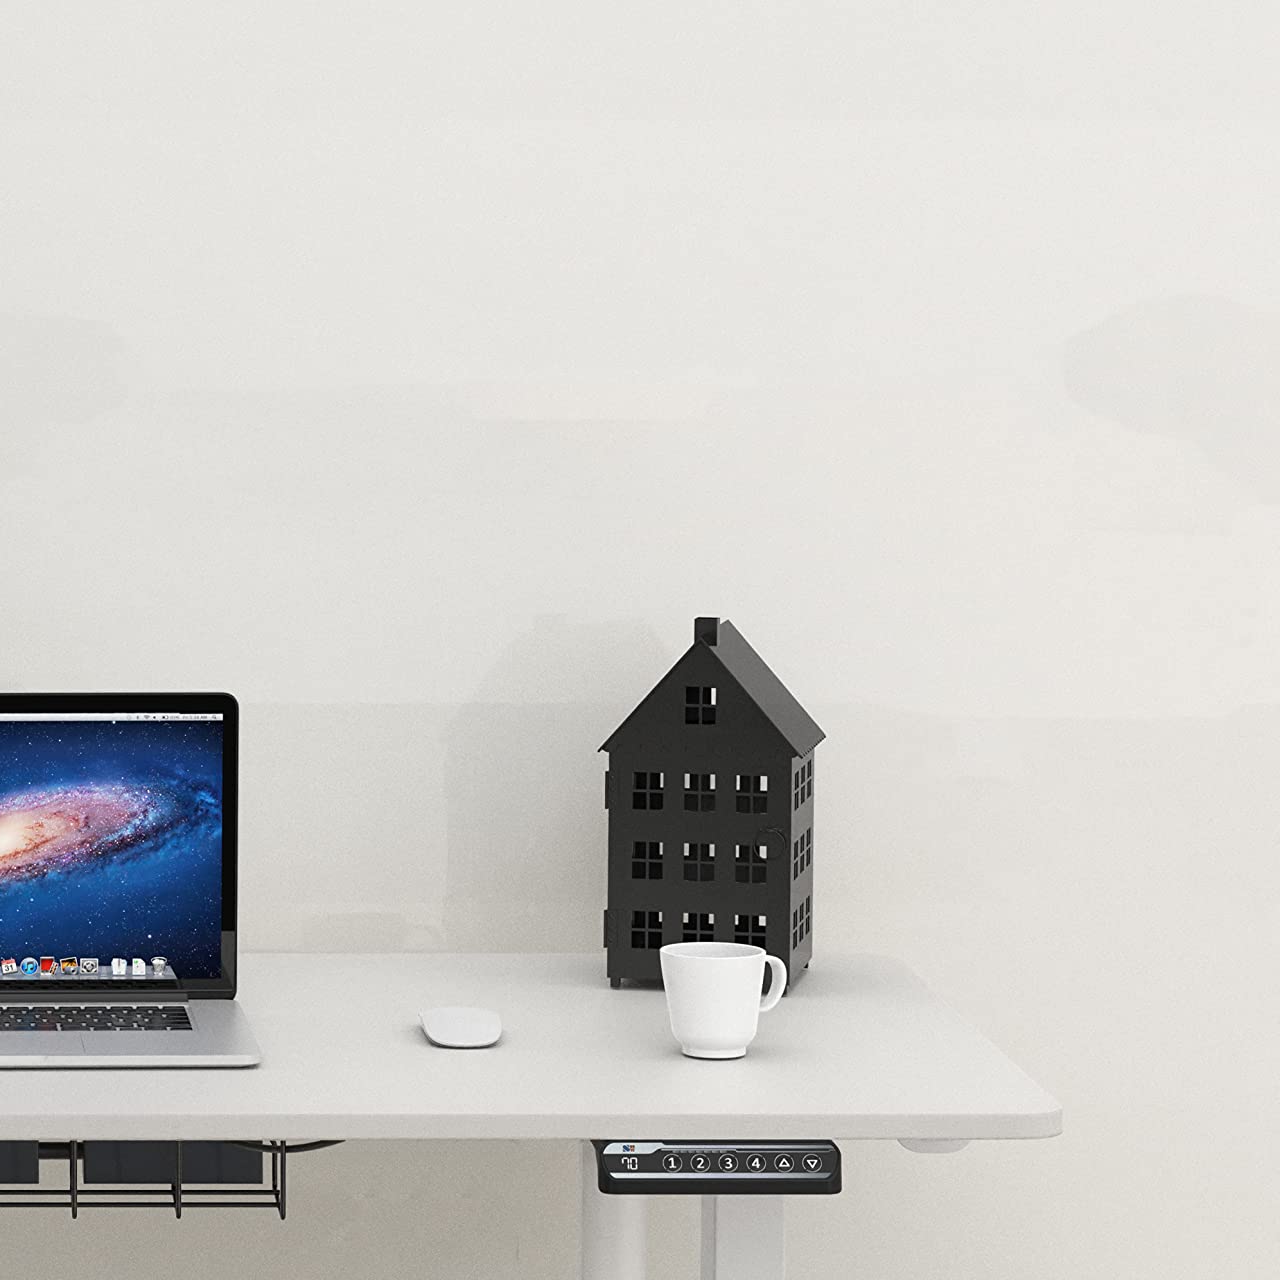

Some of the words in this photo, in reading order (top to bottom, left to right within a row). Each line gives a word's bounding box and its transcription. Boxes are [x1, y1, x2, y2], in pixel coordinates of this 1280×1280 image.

[621, 1157, 638, 1170] 70
[668, 1157, 677, 1169] 1
[696, 1157, 705, 1169] 2
[724, 1157, 733, 1169] 3
[751, 1157, 761, 1169] 4
